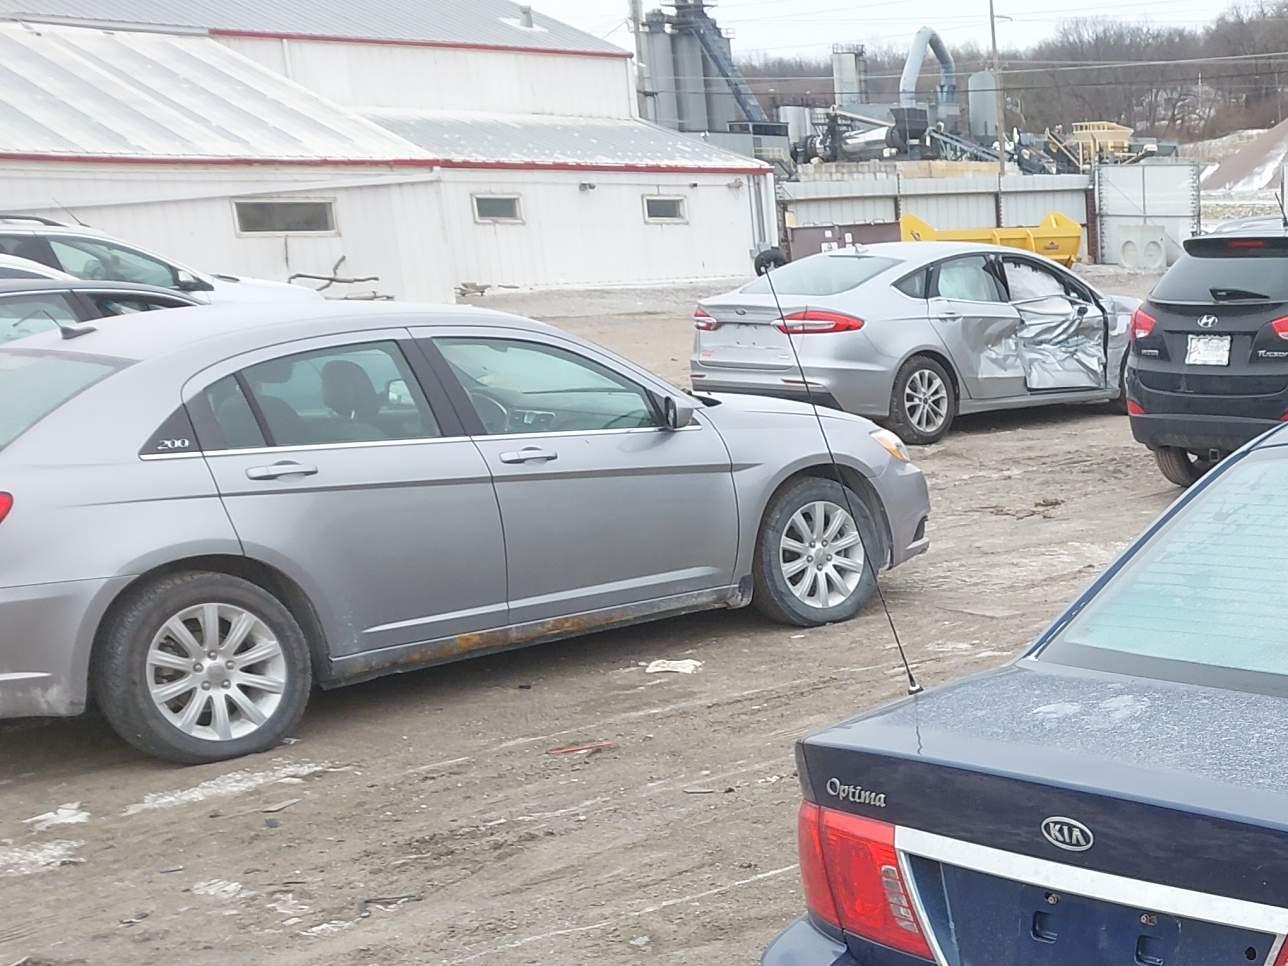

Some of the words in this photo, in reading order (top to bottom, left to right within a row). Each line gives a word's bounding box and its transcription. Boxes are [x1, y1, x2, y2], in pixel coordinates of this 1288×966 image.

[157, 438, 189, 449] 200
[826, 777, 887, 808] Optima
[1048, 822, 1087, 846] KIA
